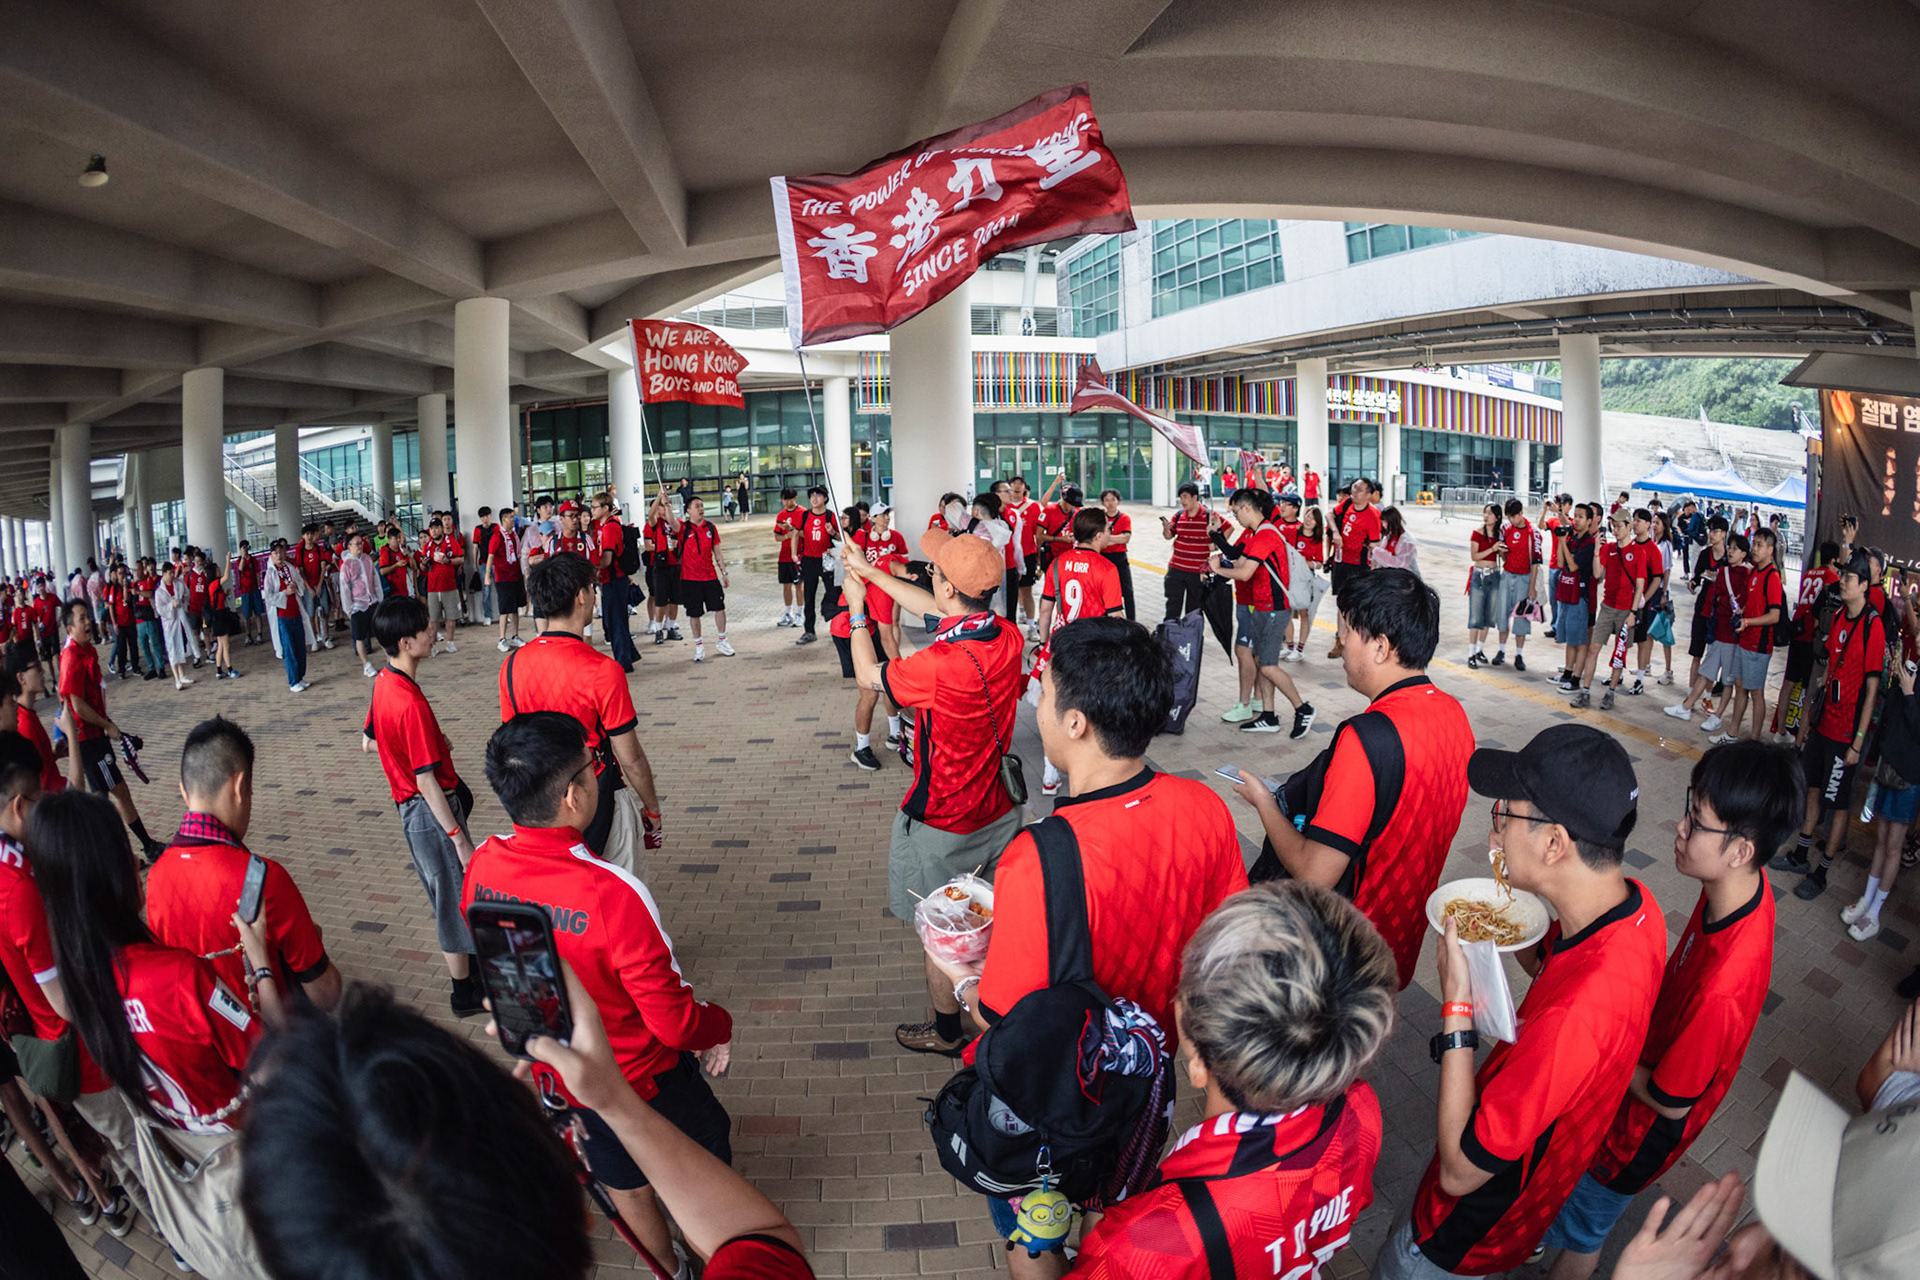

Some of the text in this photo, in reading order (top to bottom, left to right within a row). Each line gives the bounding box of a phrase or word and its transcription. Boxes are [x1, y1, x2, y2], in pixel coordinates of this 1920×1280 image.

[802, 198, 843, 216] THE
[849, 159, 912, 216] POWER
[902, 238, 968, 297] SINCE
[645, 326, 679, 349] WE
[682, 329, 712, 346] ARE
[643, 348, 699, 374] HONG
[649, 373, 691, 395] BOYS
[692, 381, 714, 393] AND
[1861, 398, 1898, 430] 철판
[811, 530, 821, 541] 10
[1064, 560, 1089, 573] M ORR
[1065, 579, 1083, 621] 9
[1799, 577, 1823, 605] 23
[1824, 755, 1844, 802] ARMY
[1264, 1236, 1286, 1275] T
[1308, 1185, 1354, 1239] YUE
